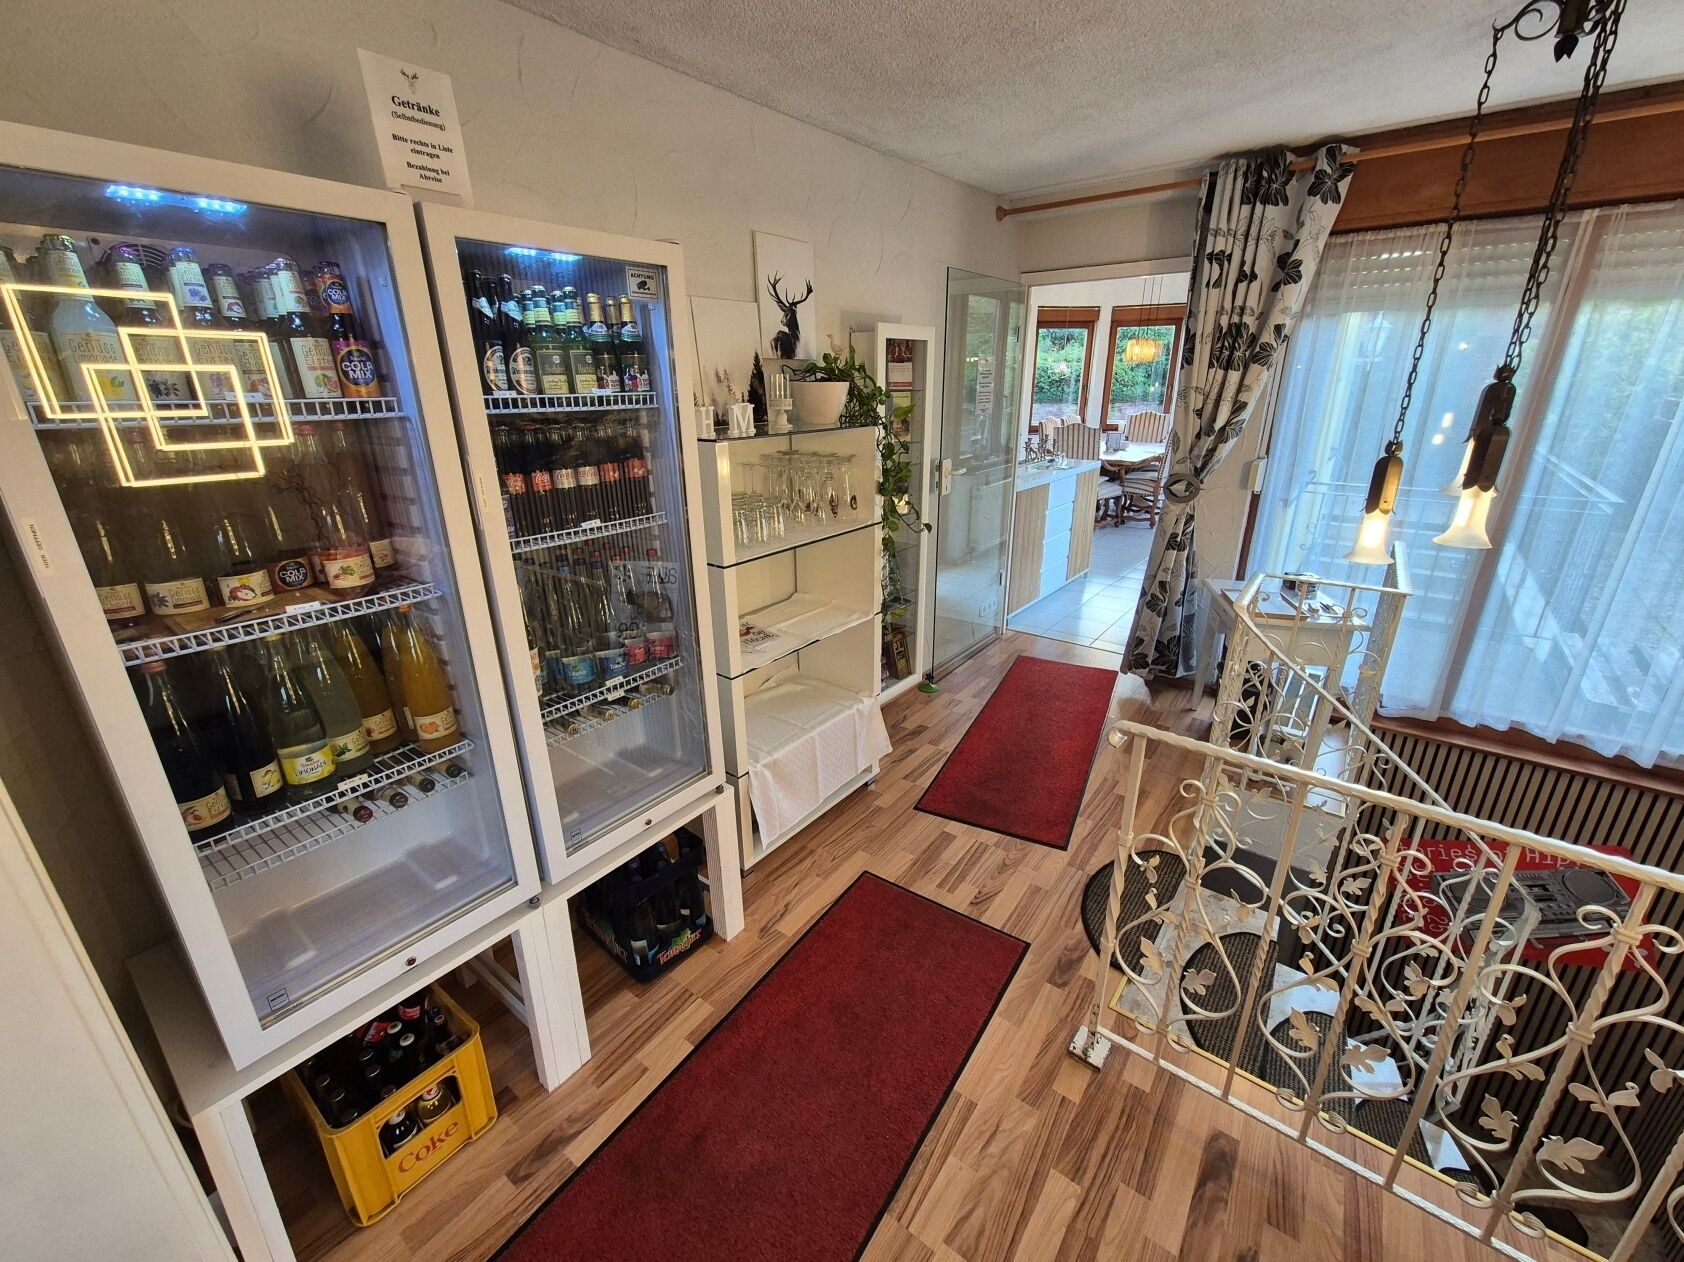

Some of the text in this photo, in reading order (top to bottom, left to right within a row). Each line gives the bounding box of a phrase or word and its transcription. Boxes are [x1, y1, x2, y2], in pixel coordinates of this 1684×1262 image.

[391, 95, 441, 117] Getränke
[391, 111, 446, 131] (Selbstbedienung)
[391, 133, 454, 154] Bitte rechts in Liste
[410, 147, 441, 160] eintragen
[406, 161, 451, 176] Bezahlung bei
[419, 173, 443, 184] Abreise
[630, 272, 655, 280] ACHTUNG
[342, 361, 374, 371] COLA
[279, 567, 306, 578] COLA
[398, 1120, 460, 1173] Coke
